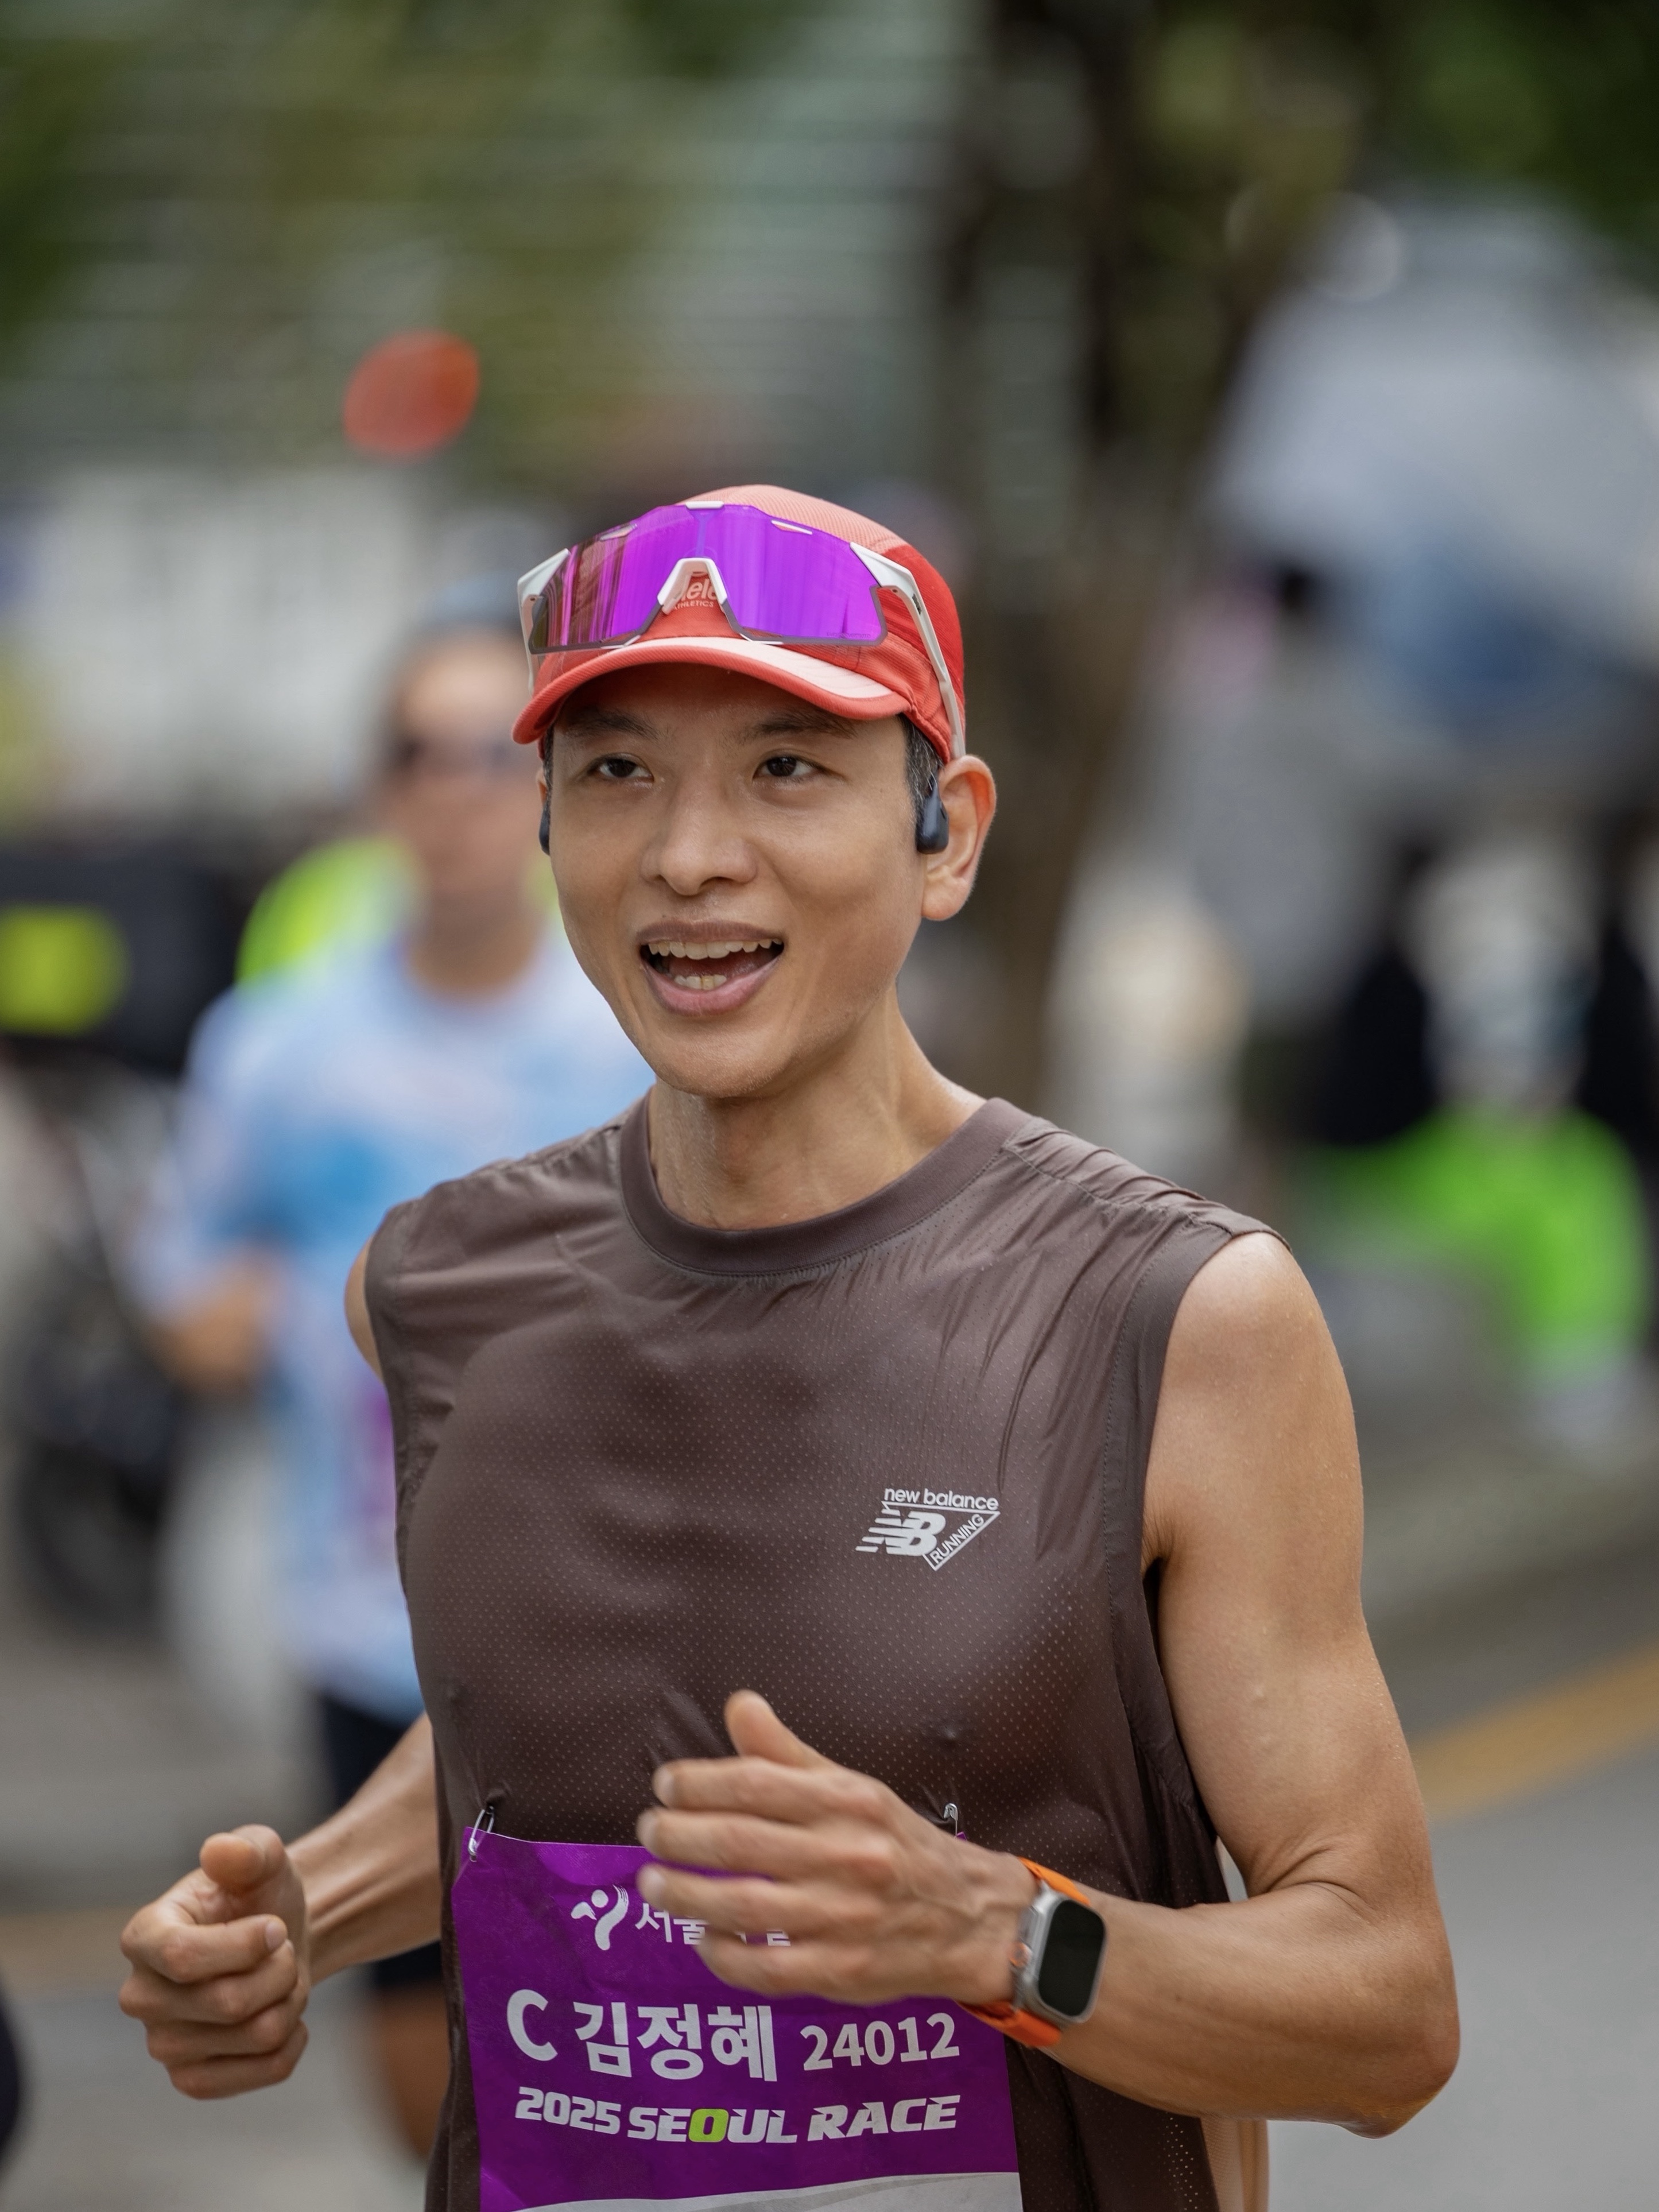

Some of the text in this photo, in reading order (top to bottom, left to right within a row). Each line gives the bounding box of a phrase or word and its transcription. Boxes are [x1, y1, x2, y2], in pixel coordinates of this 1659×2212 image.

[884, 1487, 999, 1511] new balance
[929, 1514, 984, 1564] RUNNING
[506, 1989, 960, 2082] C 김정혜 24012
[515, 2086, 960, 2144] 2025 SEOUL RACE
